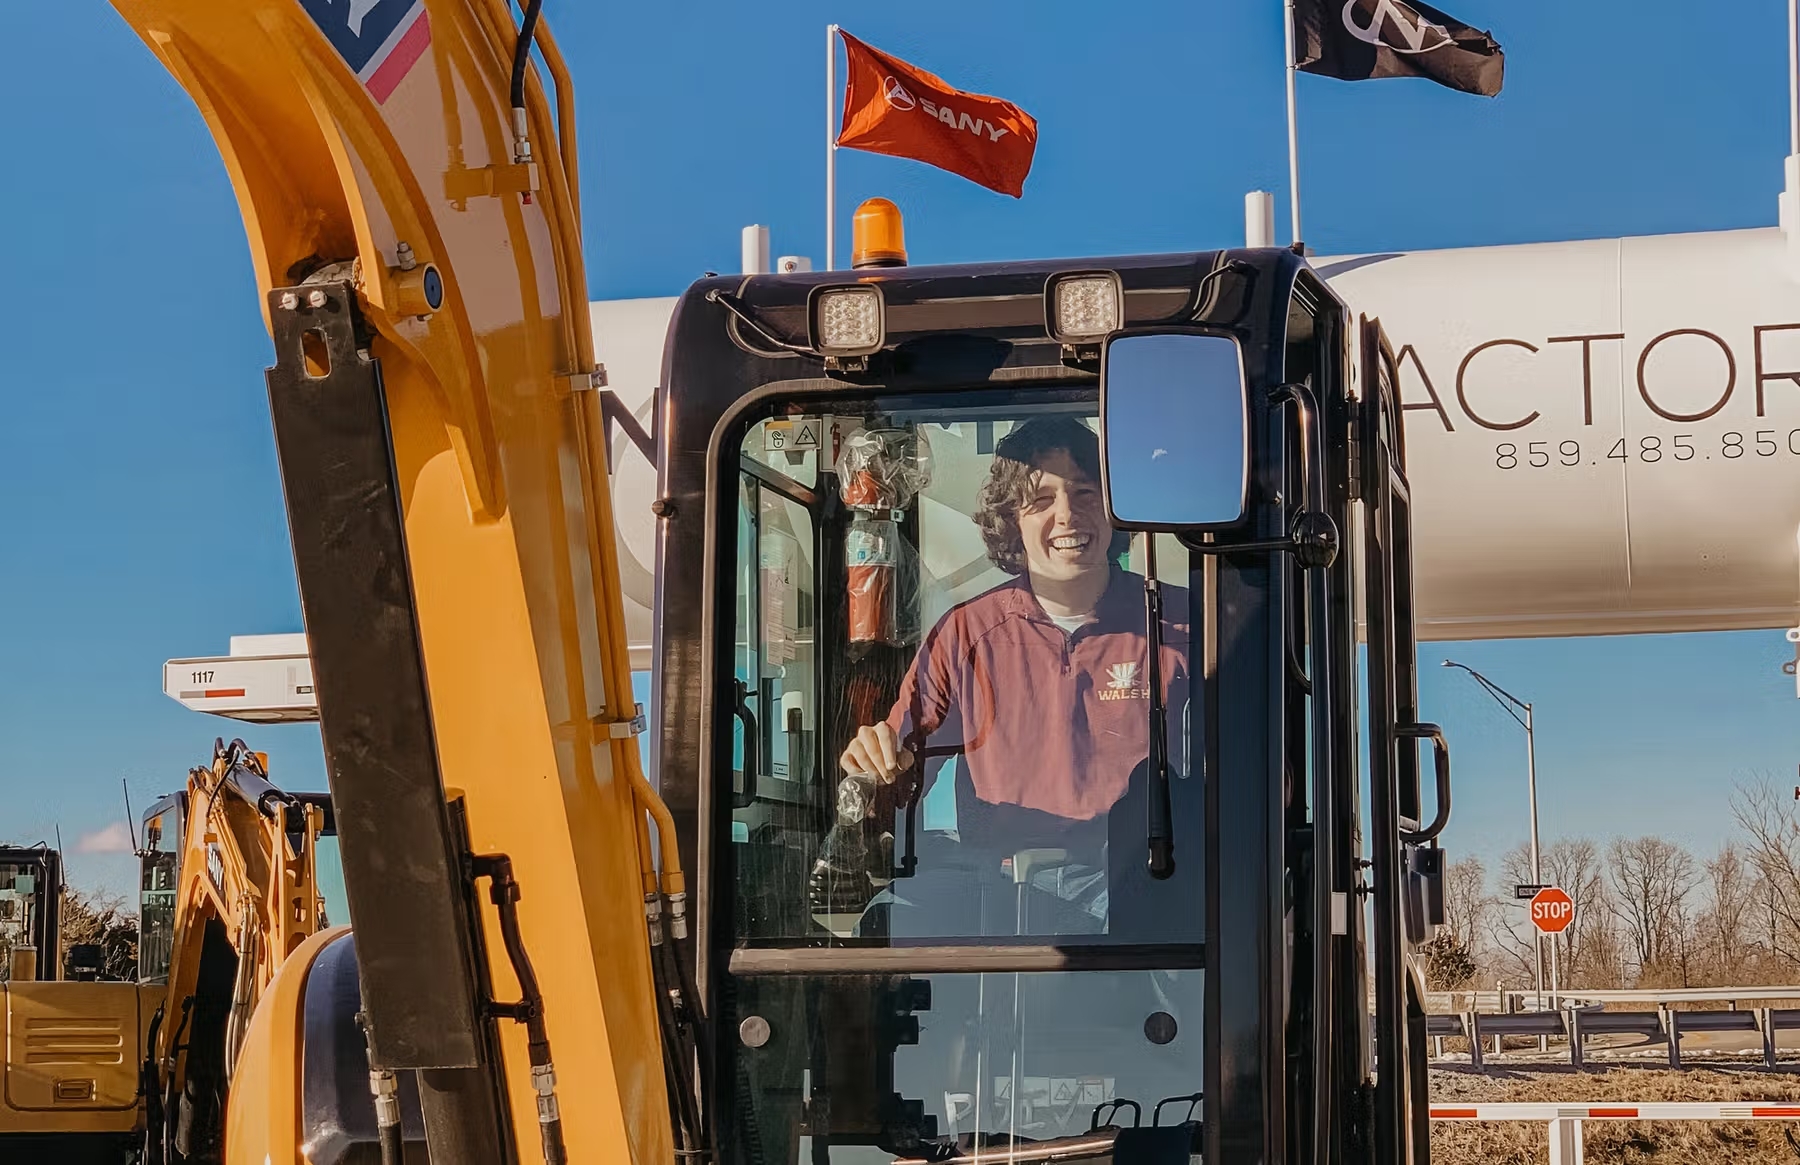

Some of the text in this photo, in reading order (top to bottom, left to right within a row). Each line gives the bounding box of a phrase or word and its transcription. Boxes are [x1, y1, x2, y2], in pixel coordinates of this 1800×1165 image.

[919, 97, 1008, 142] SANY
[192, 671, 214, 683] 1117
[1097, 688, 1150, 701] WALSH
[1533, 901, 1571, 919] STOP
